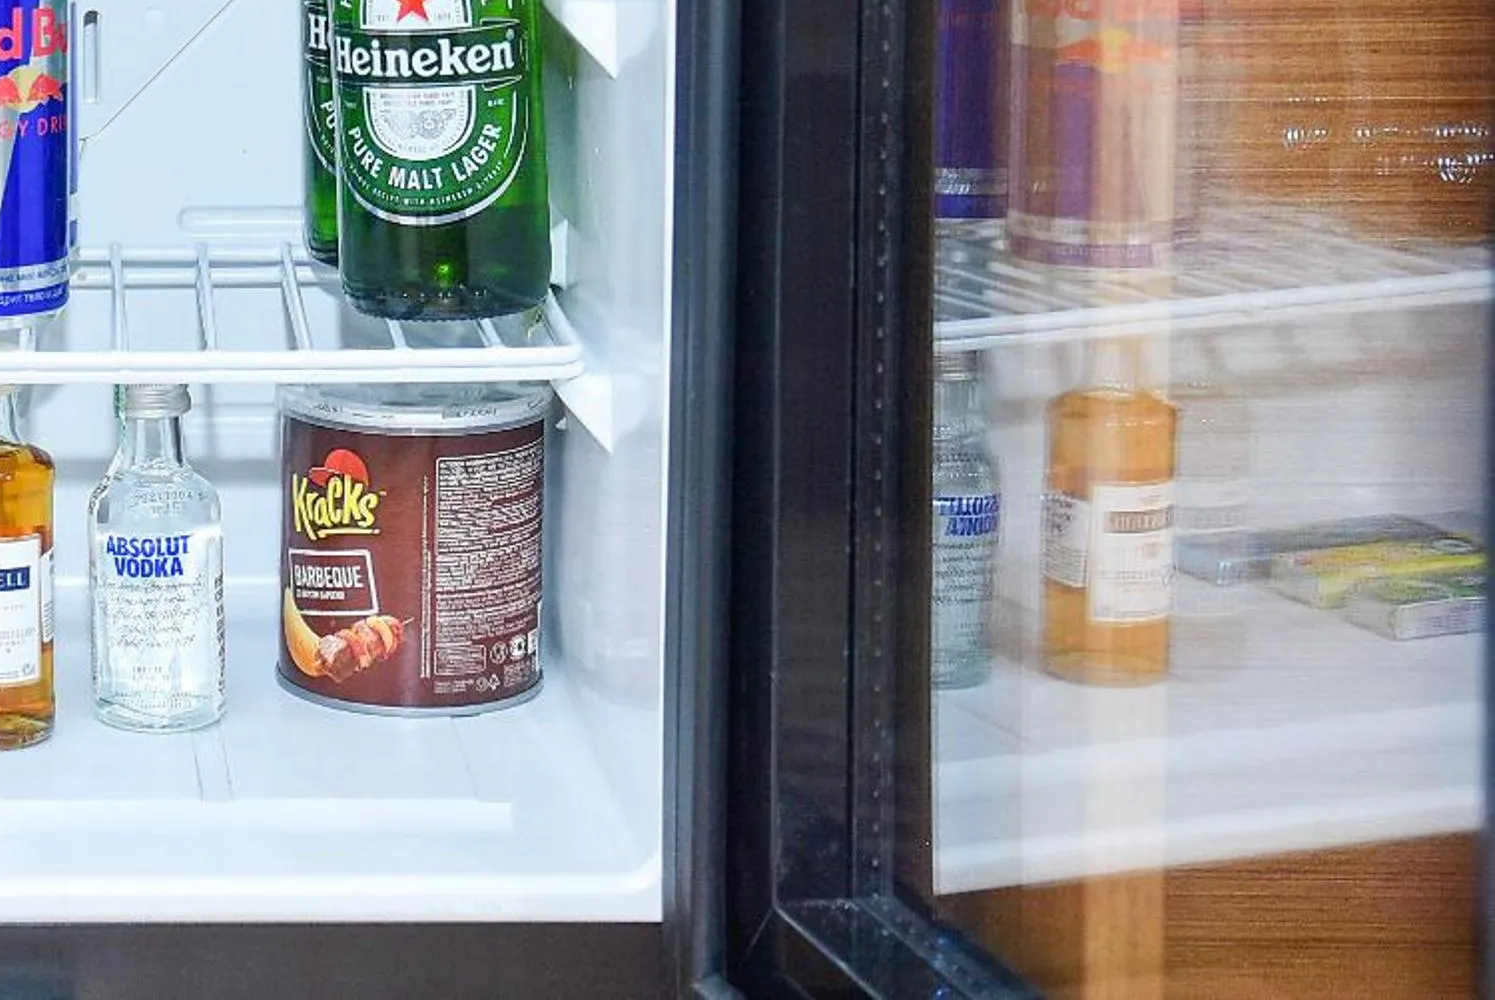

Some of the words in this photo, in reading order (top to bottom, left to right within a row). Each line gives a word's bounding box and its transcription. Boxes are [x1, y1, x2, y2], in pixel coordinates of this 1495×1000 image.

[336, 35, 514, 79] Heineken
[348, 126, 384, 179] PURE
[388, 165, 444, 191] MALT
[451, 123, 502, 182] LAGER
[107, 535, 191, 558] ABSOLUT
[114, 557, 184, 578] VODKA
[294, 565, 364, 588] BARBEQUE
